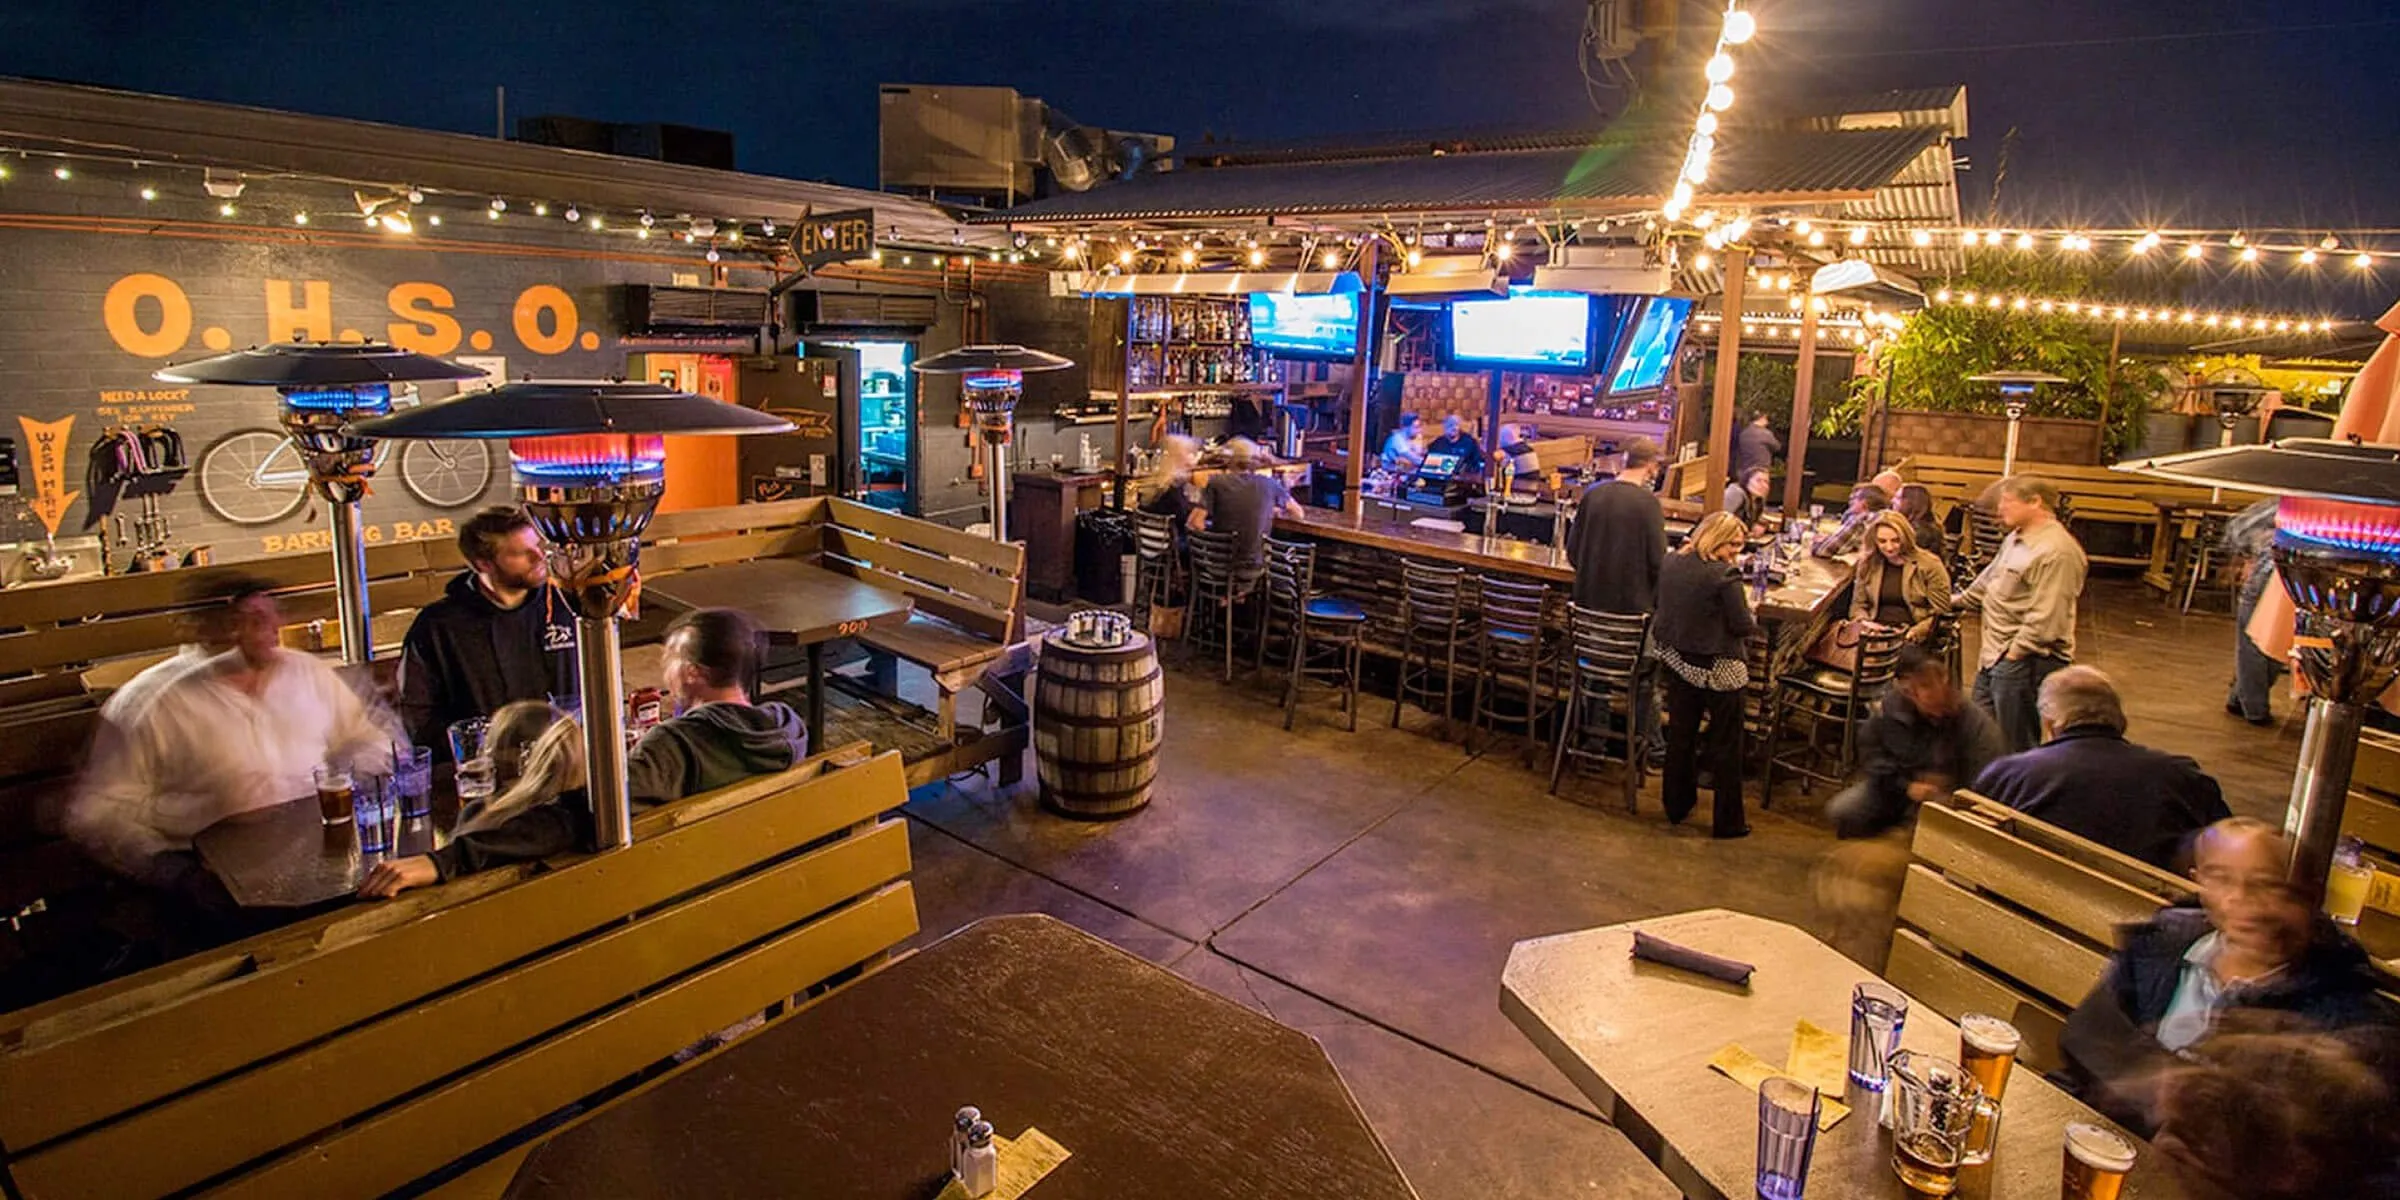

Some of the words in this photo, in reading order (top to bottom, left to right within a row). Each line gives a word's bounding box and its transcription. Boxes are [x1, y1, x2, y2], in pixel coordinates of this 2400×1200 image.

[802, 219, 867, 254] ENTER
[100, 391, 135, 403] NEED
[393, 518, 455, 543] BAR
